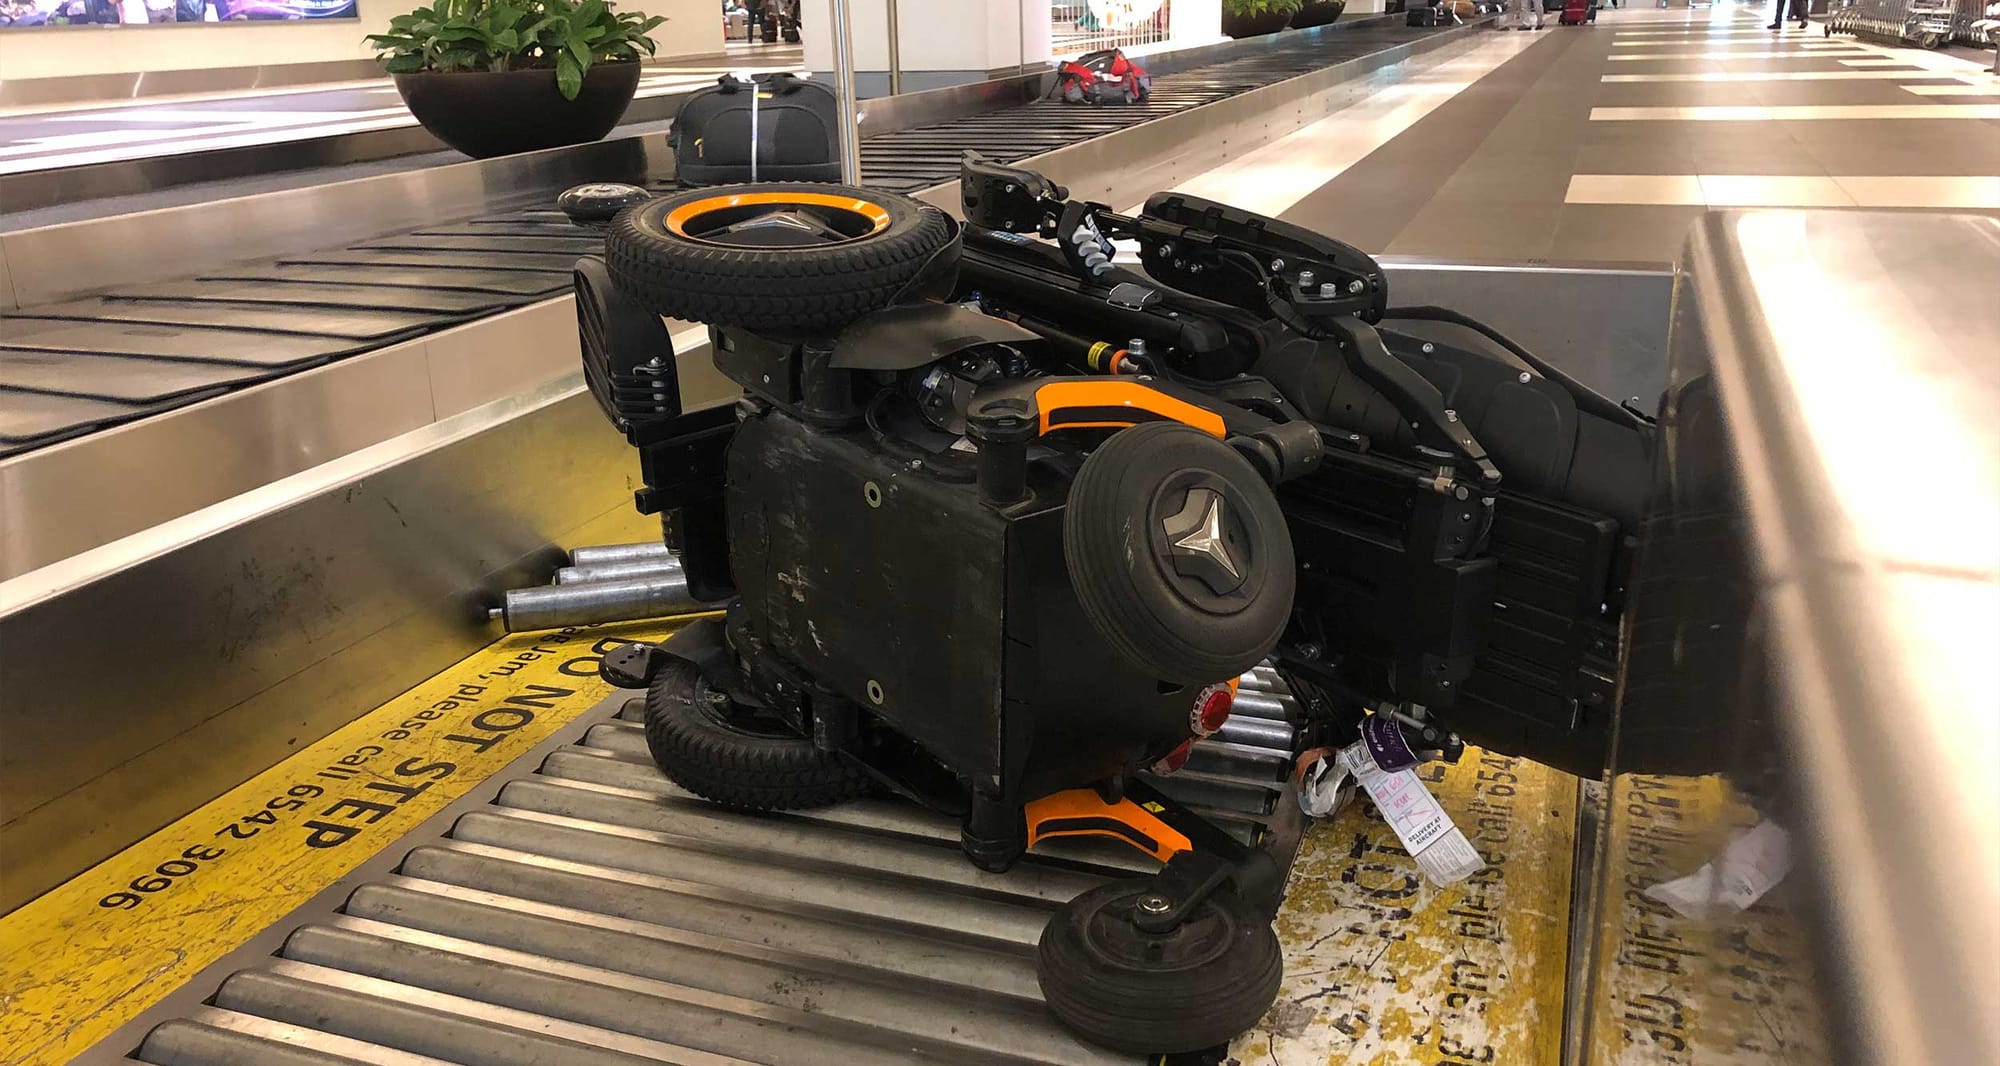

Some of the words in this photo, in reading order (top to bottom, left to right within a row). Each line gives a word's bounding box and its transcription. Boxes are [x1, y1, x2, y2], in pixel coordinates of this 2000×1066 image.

[381, 682, 487, 741] please
[443, 685, 577, 754] NOT
[315, 744, 383, 781] call
[1471, 749, 1521, 797] 654
[216, 783, 325, 840] 6542
[303, 756, 456, 850] STEP
[1408, 821, 1435, 843] DELIVERY
[1431, 816, 1442, 826] AT
[1416, 824, 1442, 846] AIRCRAFT
[98, 843, 226, 912] 3096
